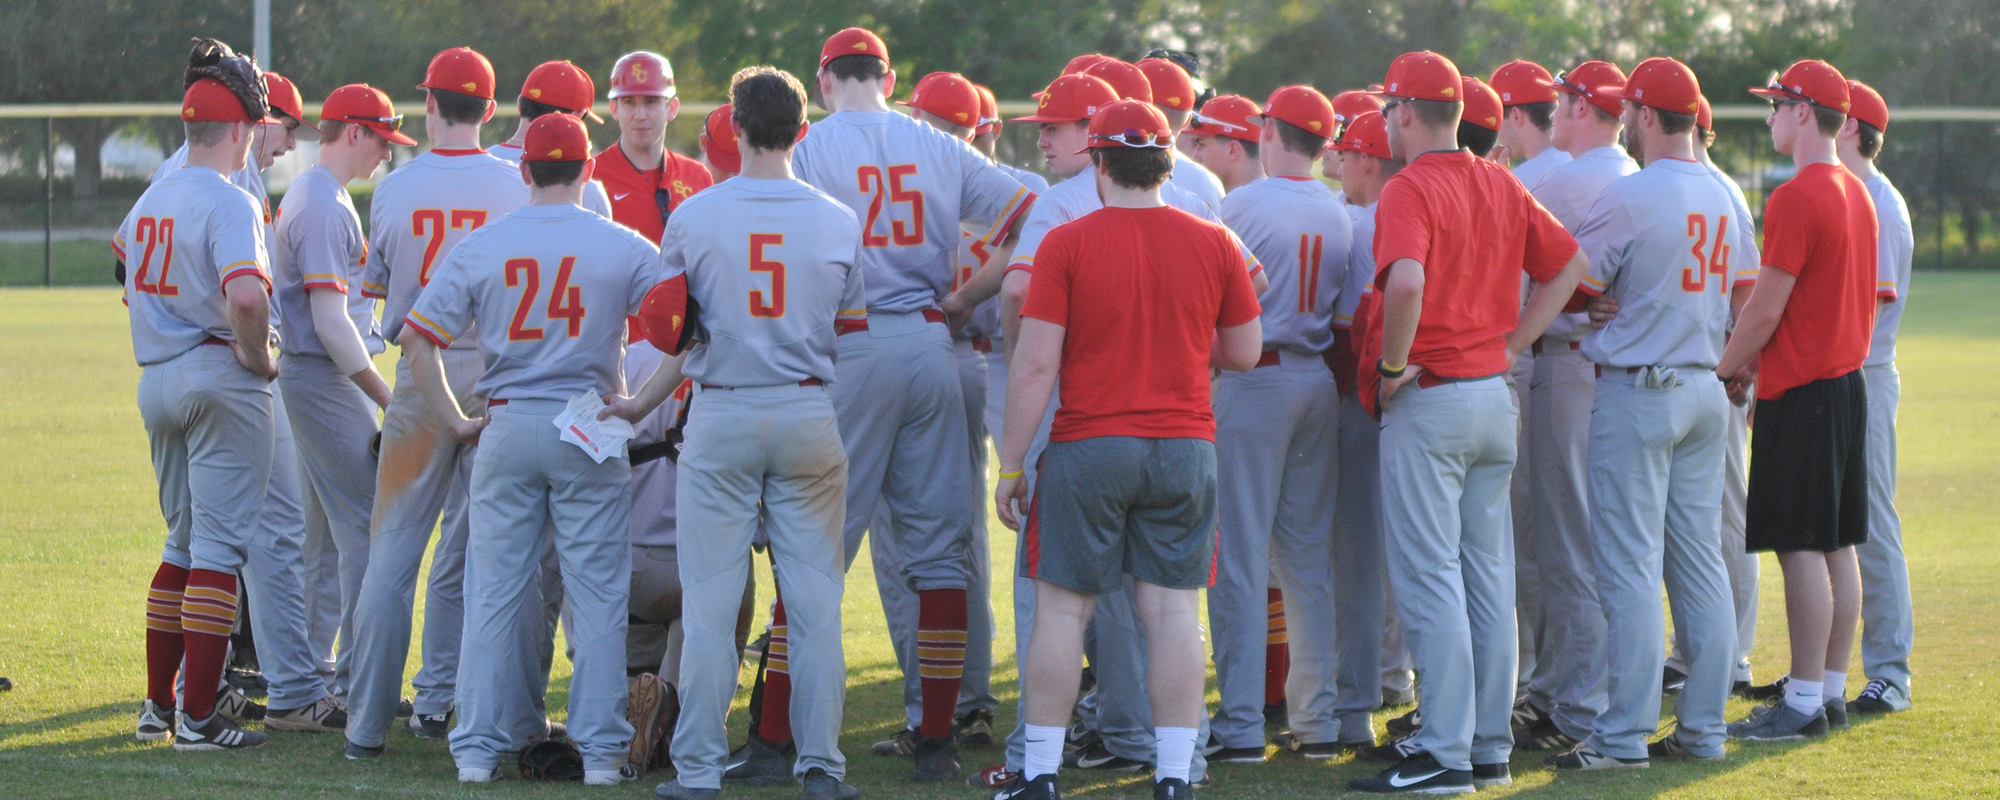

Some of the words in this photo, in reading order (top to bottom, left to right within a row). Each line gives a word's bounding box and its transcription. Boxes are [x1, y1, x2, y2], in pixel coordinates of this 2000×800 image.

[631, 63, 648, 83] SC
[857, 164, 925, 247] 25
[134, 216, 179, 296] 22
[748, 232, 786, 318] 5
[1298, 232, 1323, 314] 11
[1681, 212, 1731, 295] 34
[504, 255, 586, 342] 24
